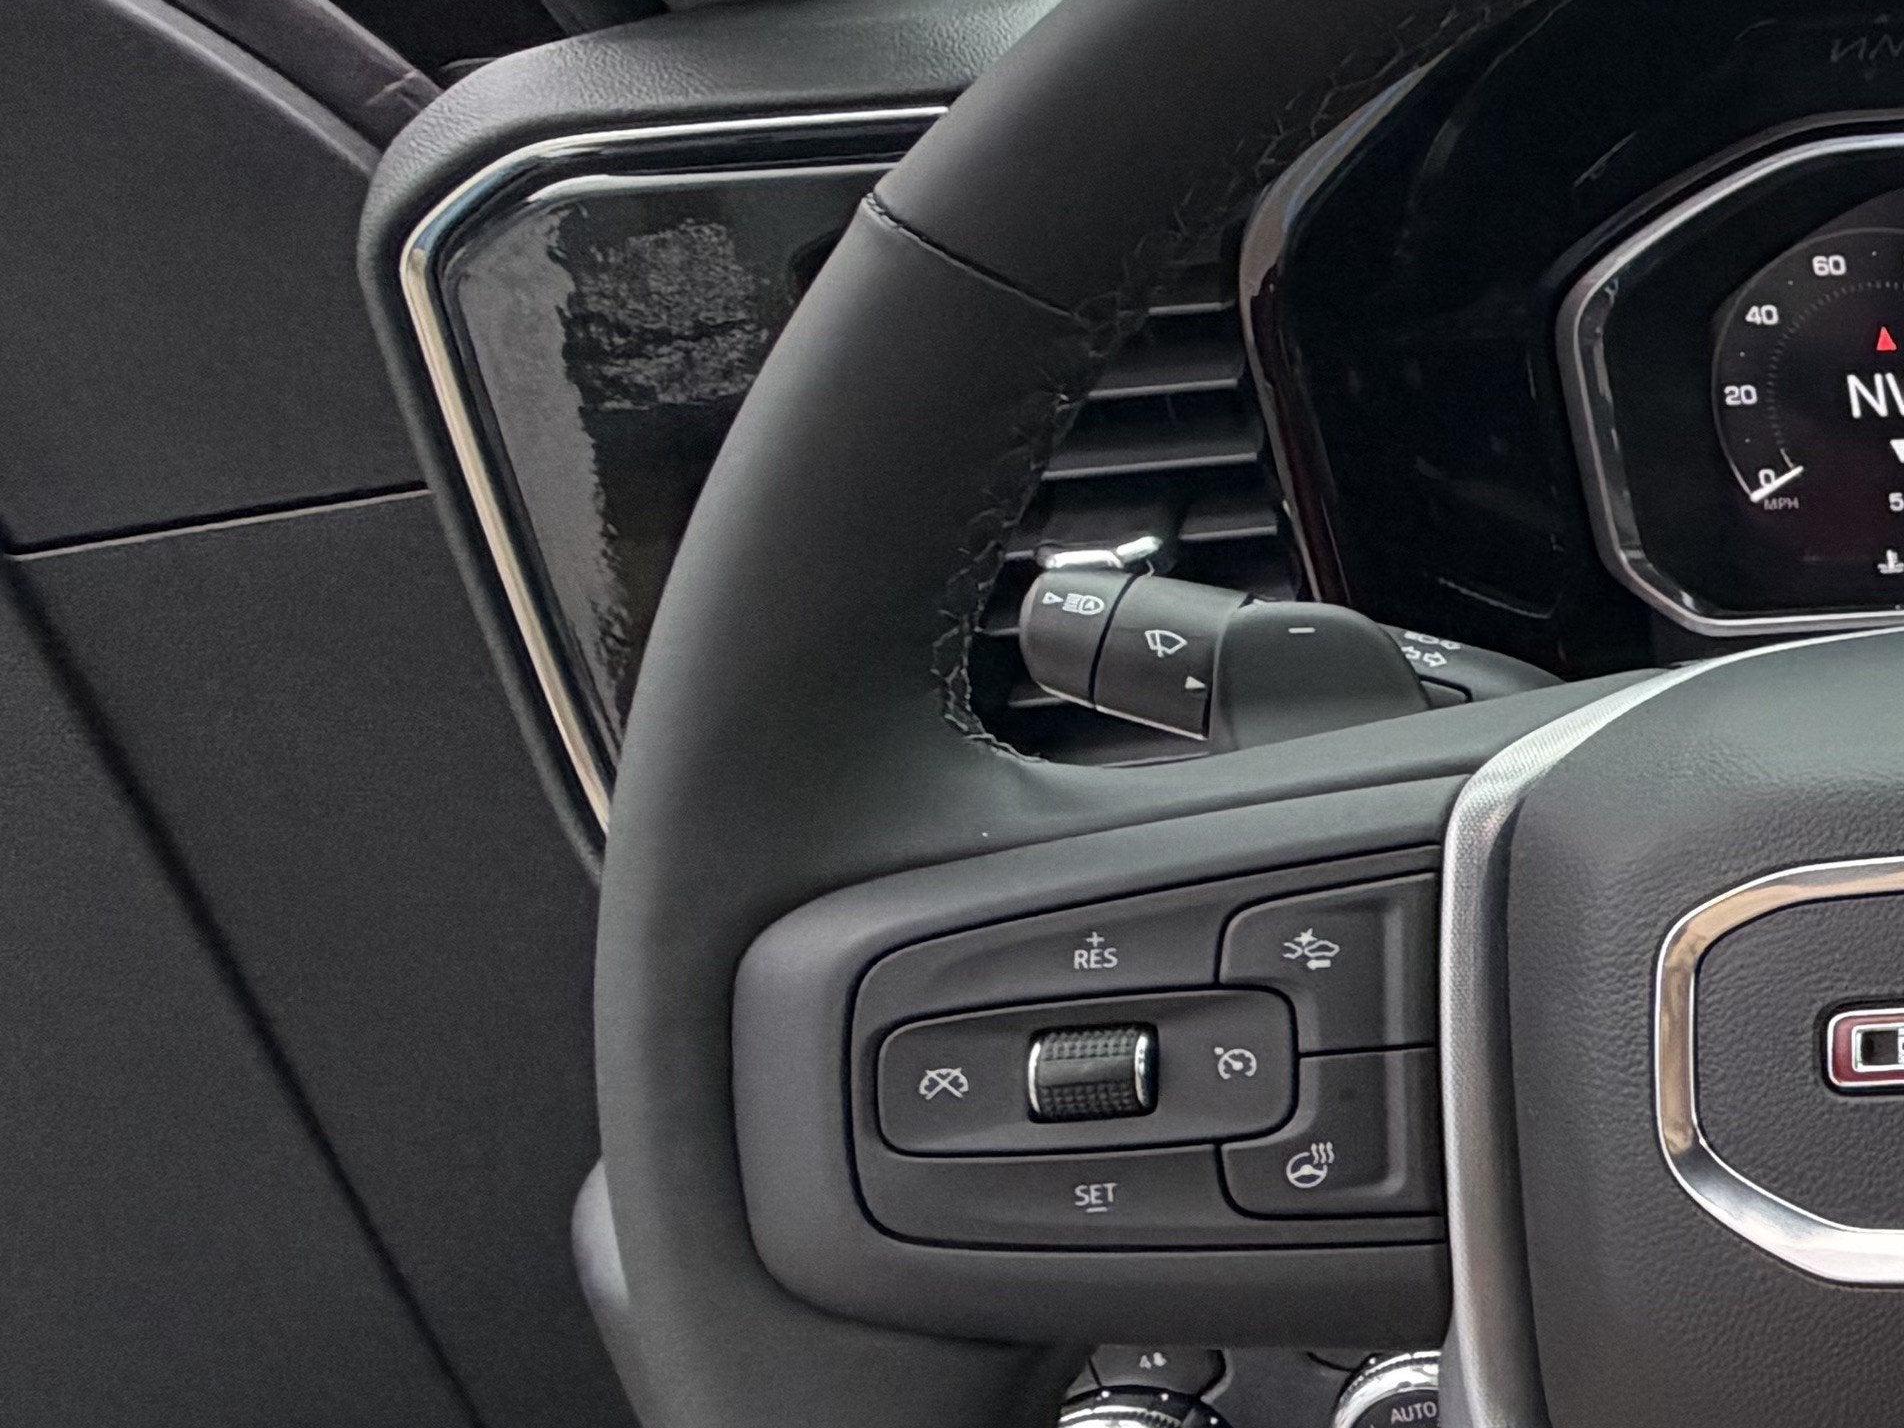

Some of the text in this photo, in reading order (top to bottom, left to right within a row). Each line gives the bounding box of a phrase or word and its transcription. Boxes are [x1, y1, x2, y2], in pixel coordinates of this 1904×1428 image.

[1812, 254, 1847, 277] 60
[1745, 304, 1779, 327] 40
[1723, 385, 1758, 406] 20
[1763, 495, 1800, 512] MPH
[1073, 948, 1118, 970] RES
[1073, 1182, 1119, 1206] SET
[1390, 1401, 1438, 1425] AUTO
